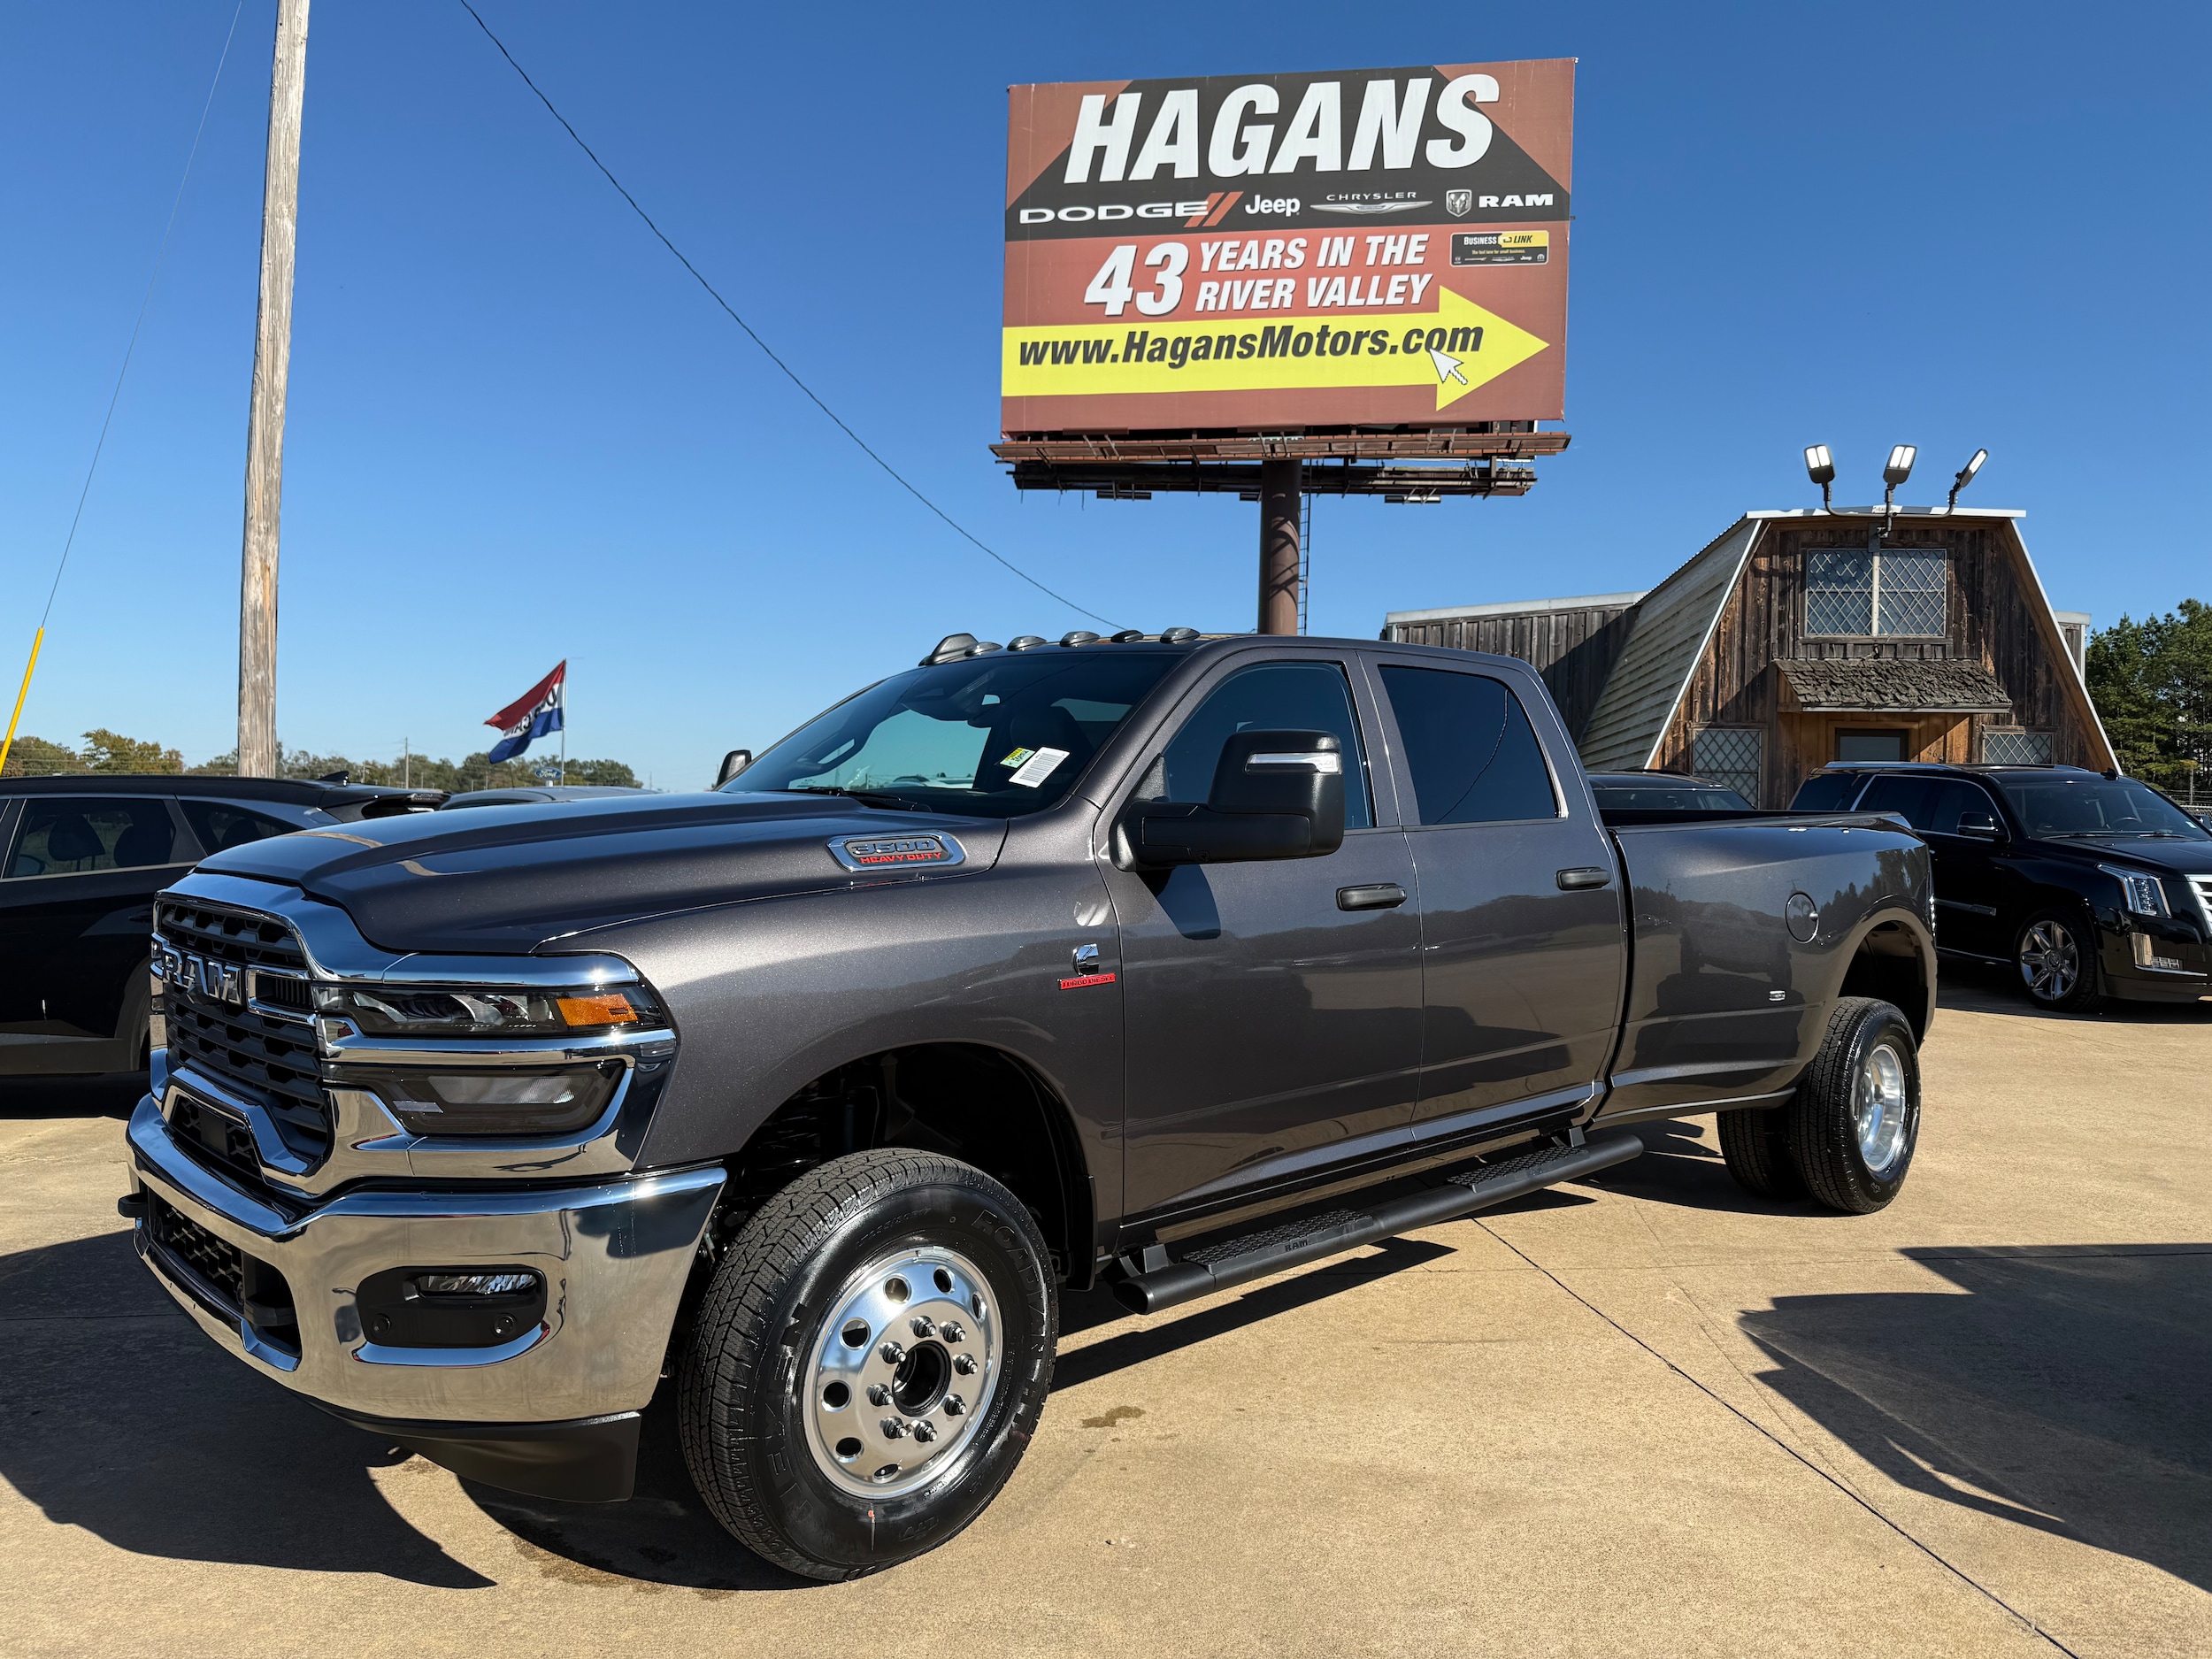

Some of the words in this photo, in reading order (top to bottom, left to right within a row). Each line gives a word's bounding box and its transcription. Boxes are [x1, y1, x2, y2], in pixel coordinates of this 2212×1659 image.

[1064, 73, 1501, 184] HAGANS
[1245, 195, 1300, 217] Jeep
[1326, 191, 1417, 202] CHRYSLER
[1479, 194, 1554, 208] RAM
[1019, 201, 1210, 224] DODGE
[1199, 237, 1306, 273] YEARS
[1317, 235, 1356, 267] IN
[1365, 234, 1431, 265] THE
[1084, 242, 1189, 316] 43
[1195, 278, 1296, 312] RIVER
[1307, 273, 1433, 308] VALLEY
[1019, 325, 1485, 369] www.HagansMotors.com
[851, 840, 936, 856] 3500
[860, 855, 905, 864] HEAVY
[906, 852, 942, 862] DUTY
[162, 945, 243, 1006] RAM
[1062, 979, 1087, 988] TURBO
[1087, 976, 1114, 985] DIESEL
[1284, 1239, 1309, 1253] RAM
